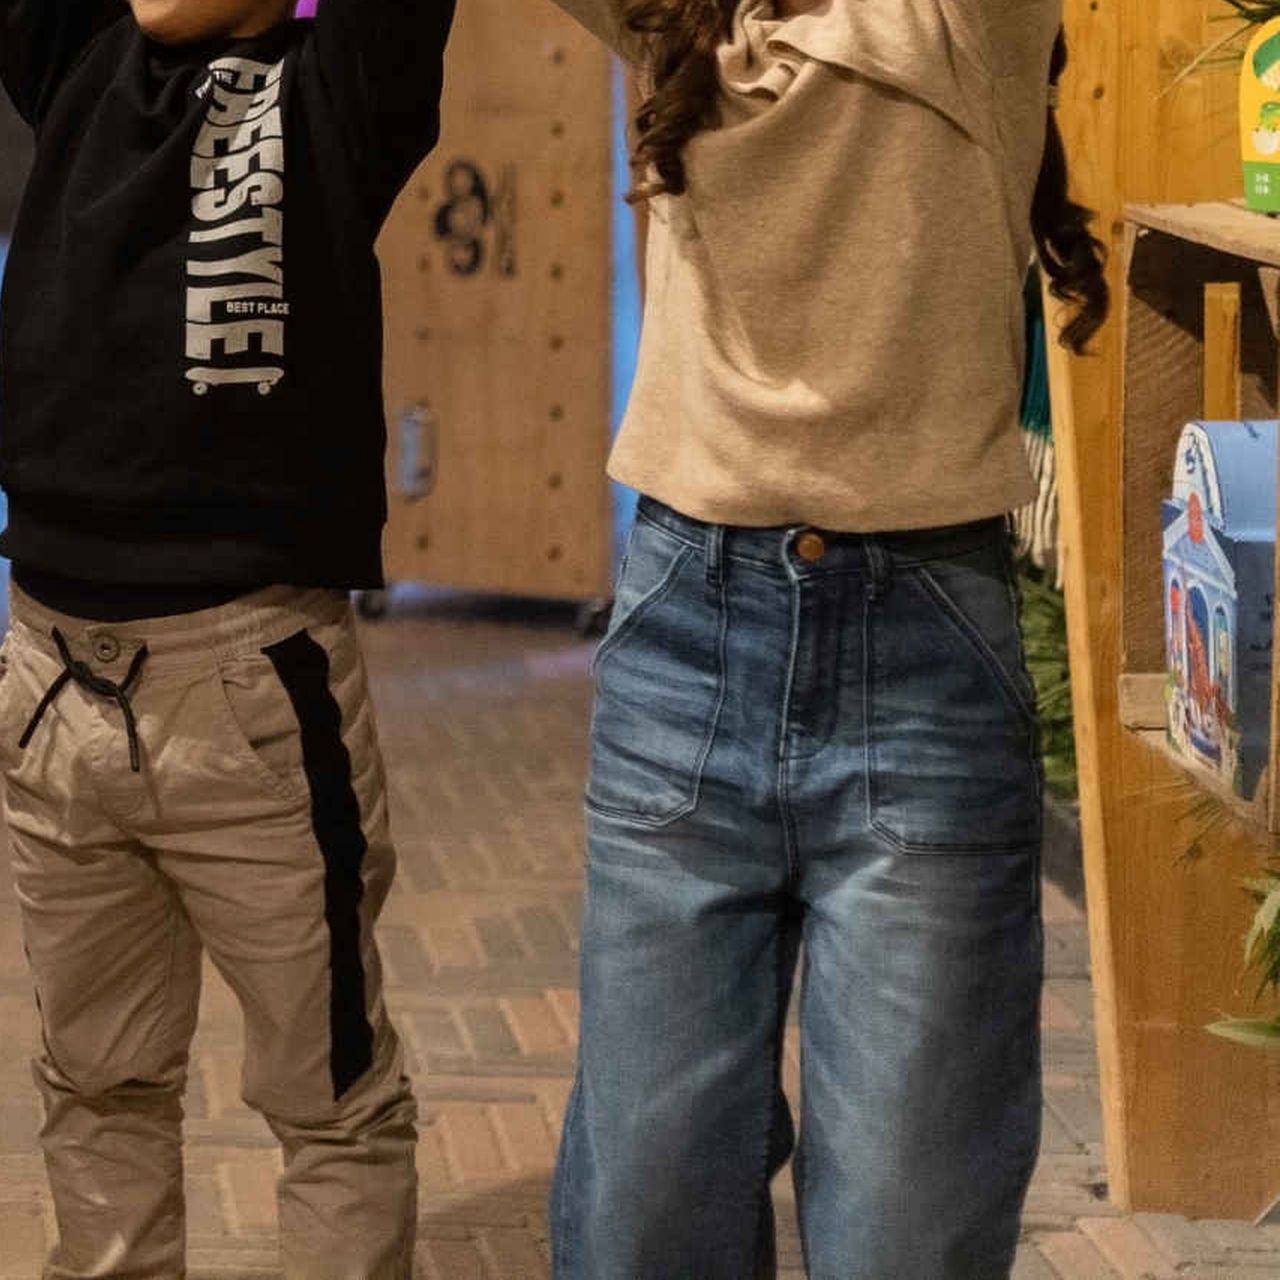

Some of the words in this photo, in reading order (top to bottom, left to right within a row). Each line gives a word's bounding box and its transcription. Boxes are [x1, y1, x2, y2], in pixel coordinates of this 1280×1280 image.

[185, 57, 285, 361] FREESTYLE
[226, 301, 255, 314] BEST
[257, 302, 291, 315] PLACE
